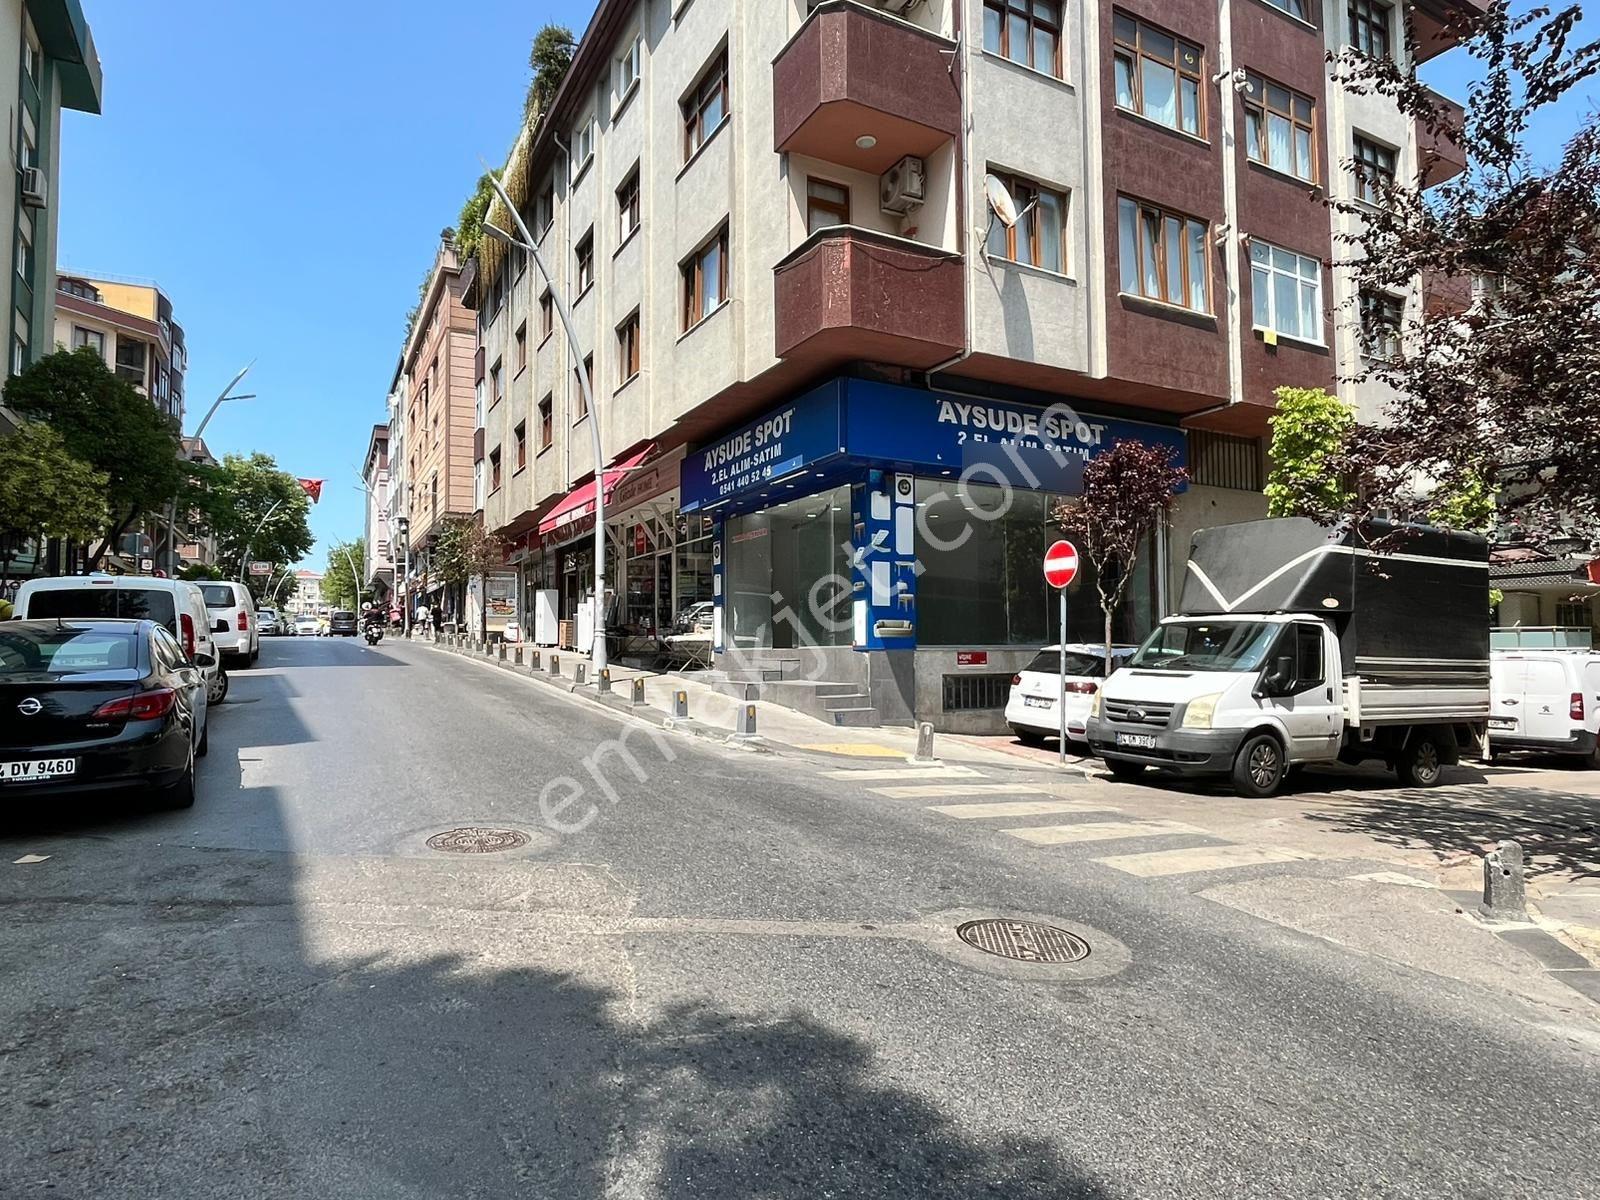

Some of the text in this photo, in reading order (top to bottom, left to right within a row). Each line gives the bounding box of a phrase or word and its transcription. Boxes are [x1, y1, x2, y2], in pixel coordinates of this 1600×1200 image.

[937, 400, 1105, 444] AYSUDE SPOT
[704, 409, 793, 472] AYSUDE SPOT
[711, 469, 728, 485] 2.EL
[11, 763, 31, 776] DV
[37, 760, 74, 774] 9460
